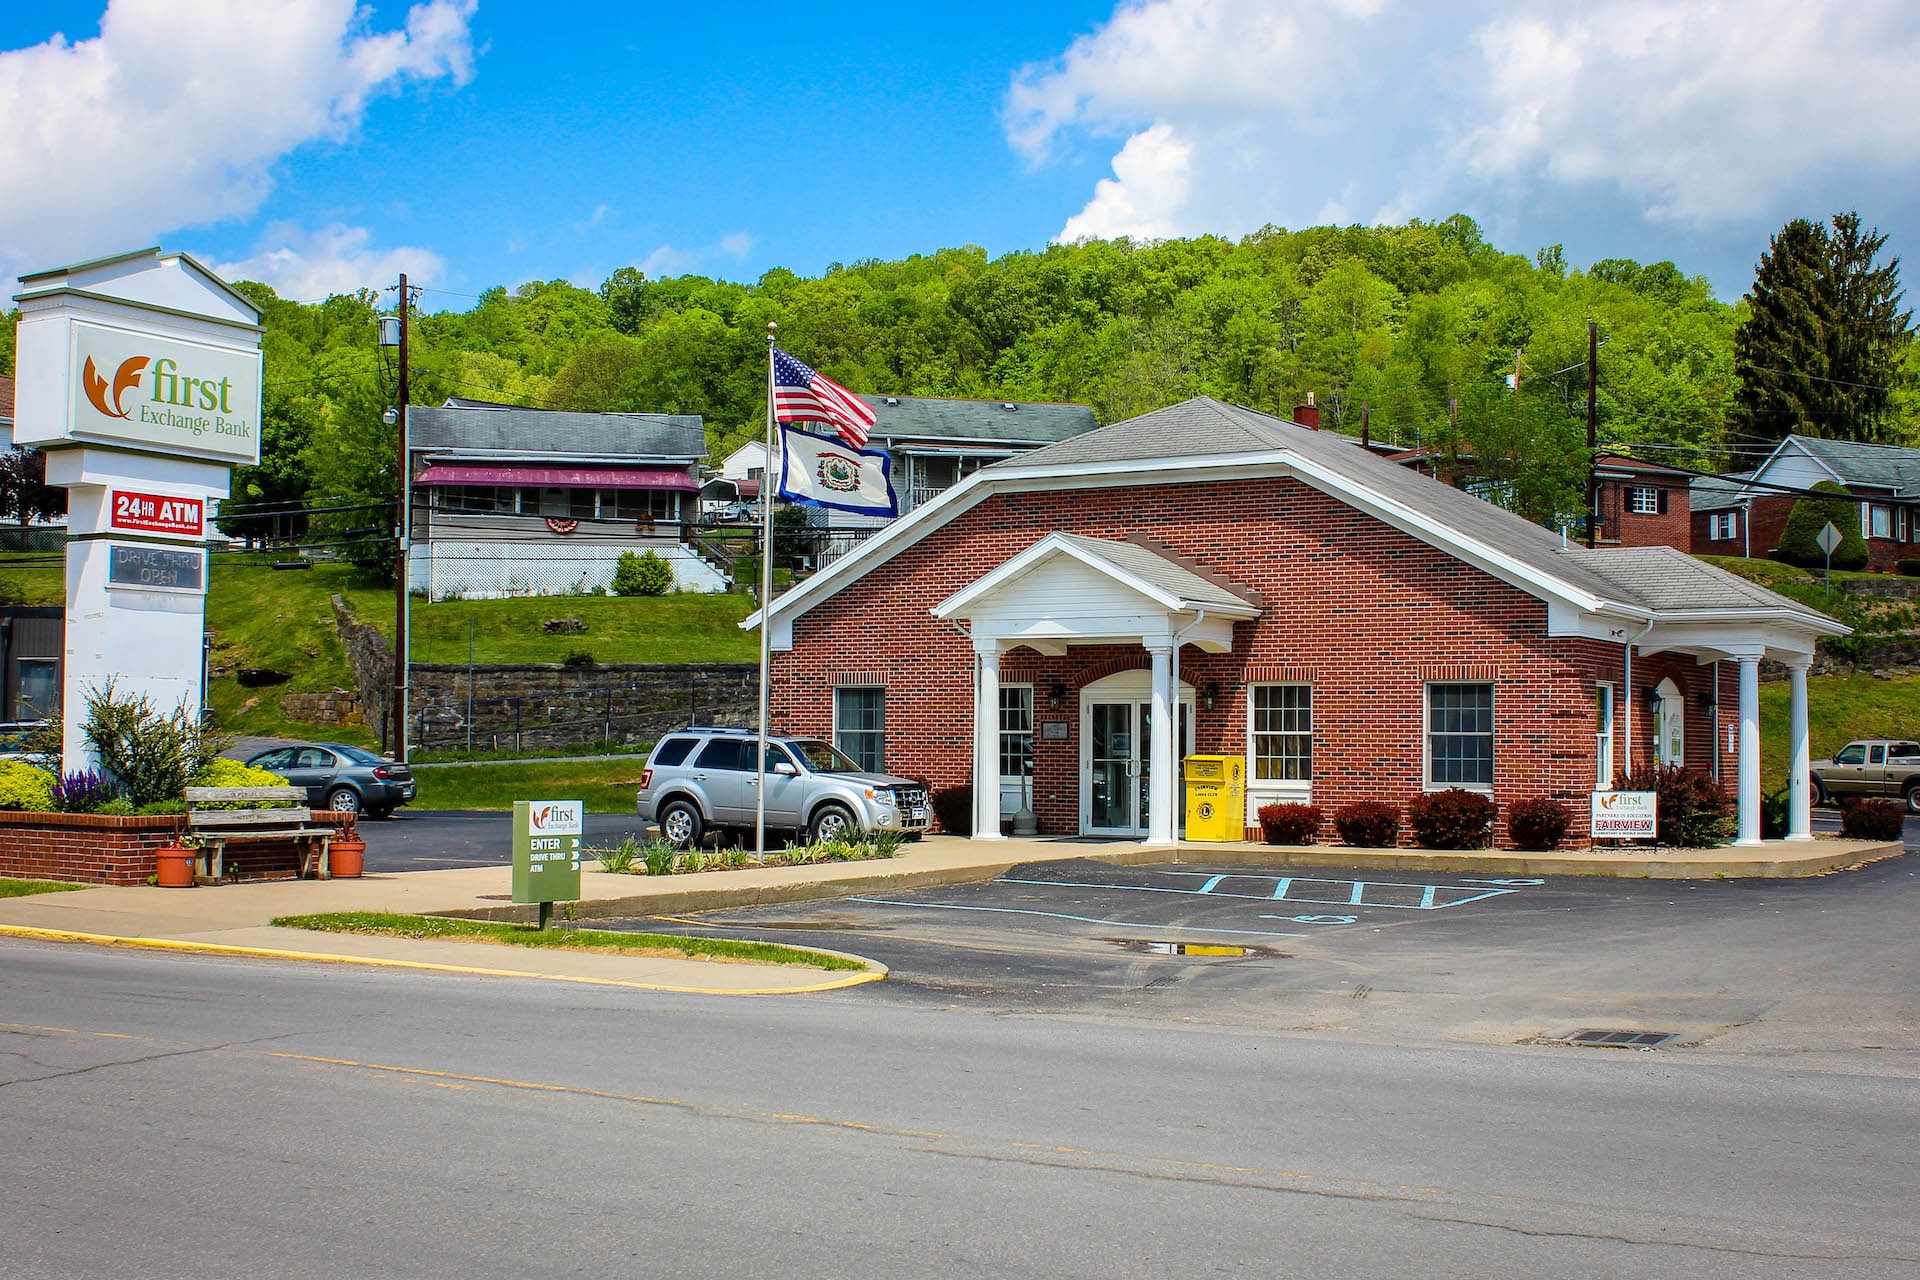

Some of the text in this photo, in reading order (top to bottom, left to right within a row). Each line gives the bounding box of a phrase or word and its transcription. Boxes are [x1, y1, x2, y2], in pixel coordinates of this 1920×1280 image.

[151, 358, 233, 415] first
[140, 404, 251, 438] Exchange Bank
[159, 501, 199, 524] ATM
[119, 549, 201, 570] DRIVE THRU
[140, 568, 178, 584] OPEN
[1619, 793, 1641, 804] first
[551, 805, 573, 821] first
[1595, 820, 1653, 831] FAIRVIEW
[530, 838, 560, 850] ENTER
[530, 852, 566, 861] DRIVE THRU
[530, 864, 544, 873] ATM
